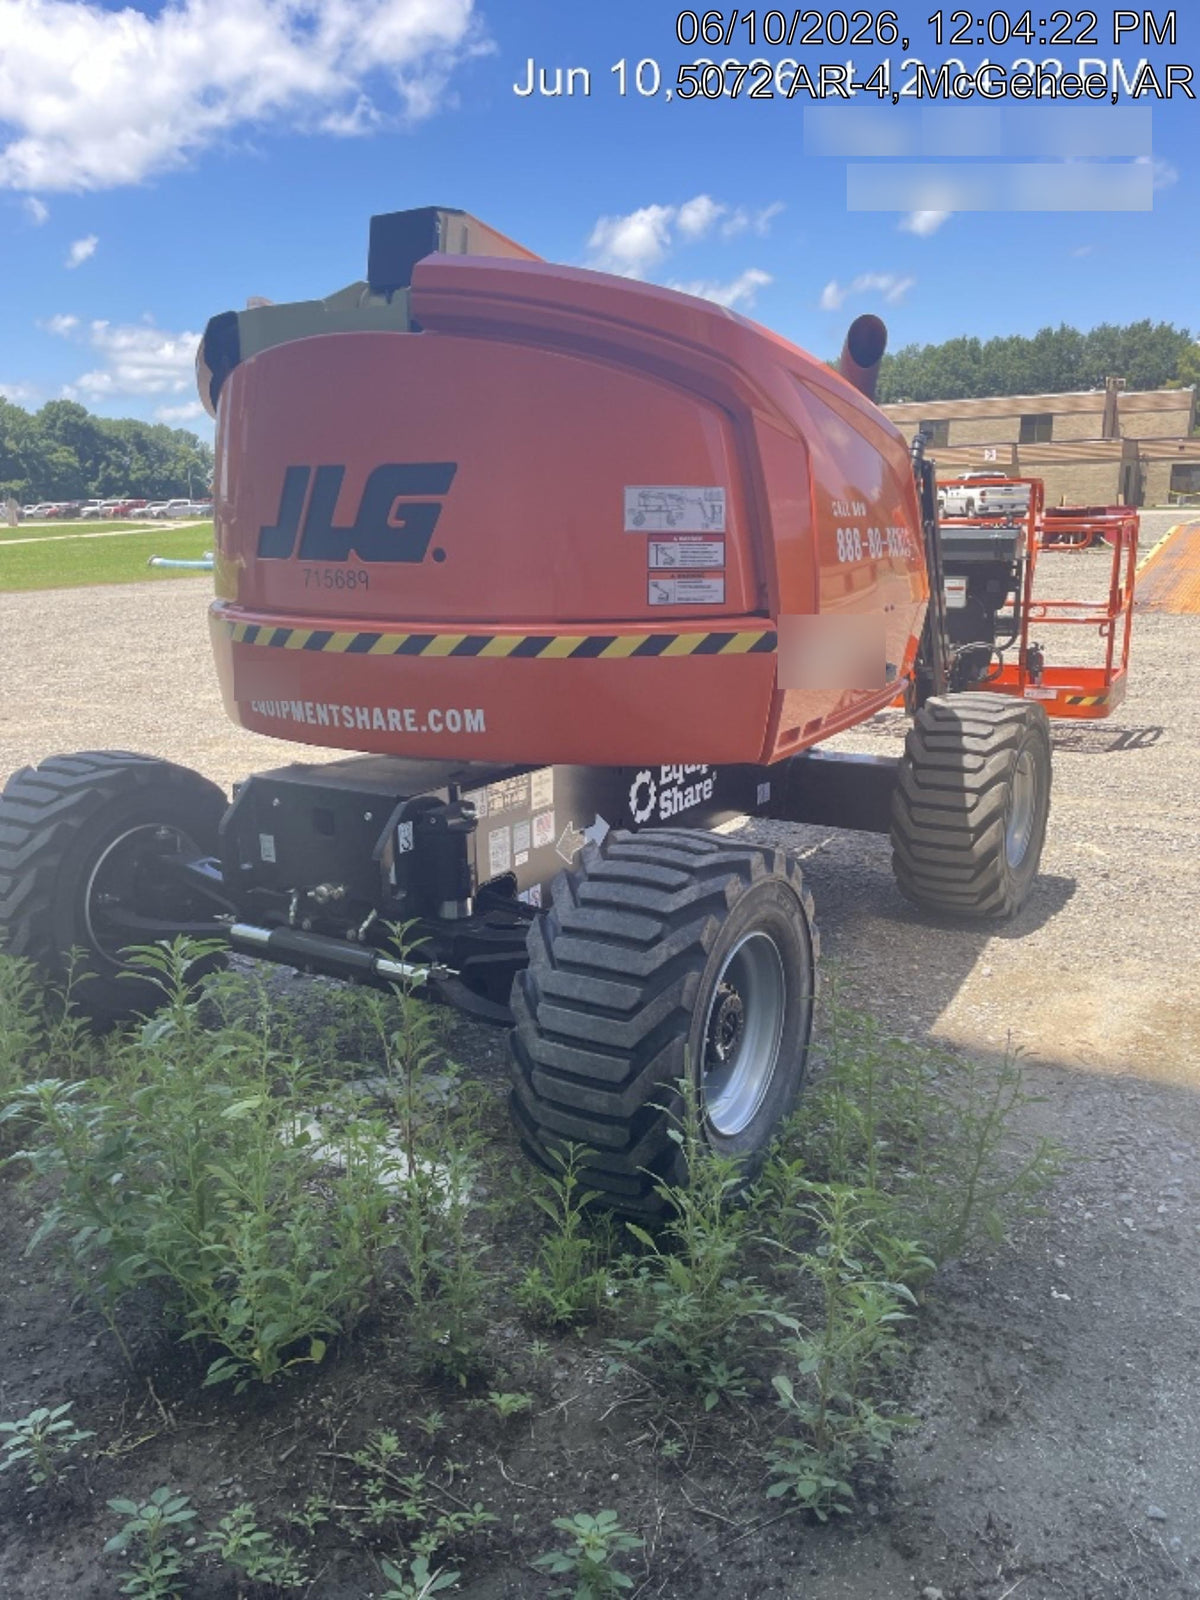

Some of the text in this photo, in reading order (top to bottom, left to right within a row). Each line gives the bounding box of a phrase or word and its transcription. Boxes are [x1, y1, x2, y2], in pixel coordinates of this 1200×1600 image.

[303, 568, 369, 591] 715689
[250, 700, 486, 733] EQUIPMENTSHARE.COM
[659, 778, 714, 820] Share
